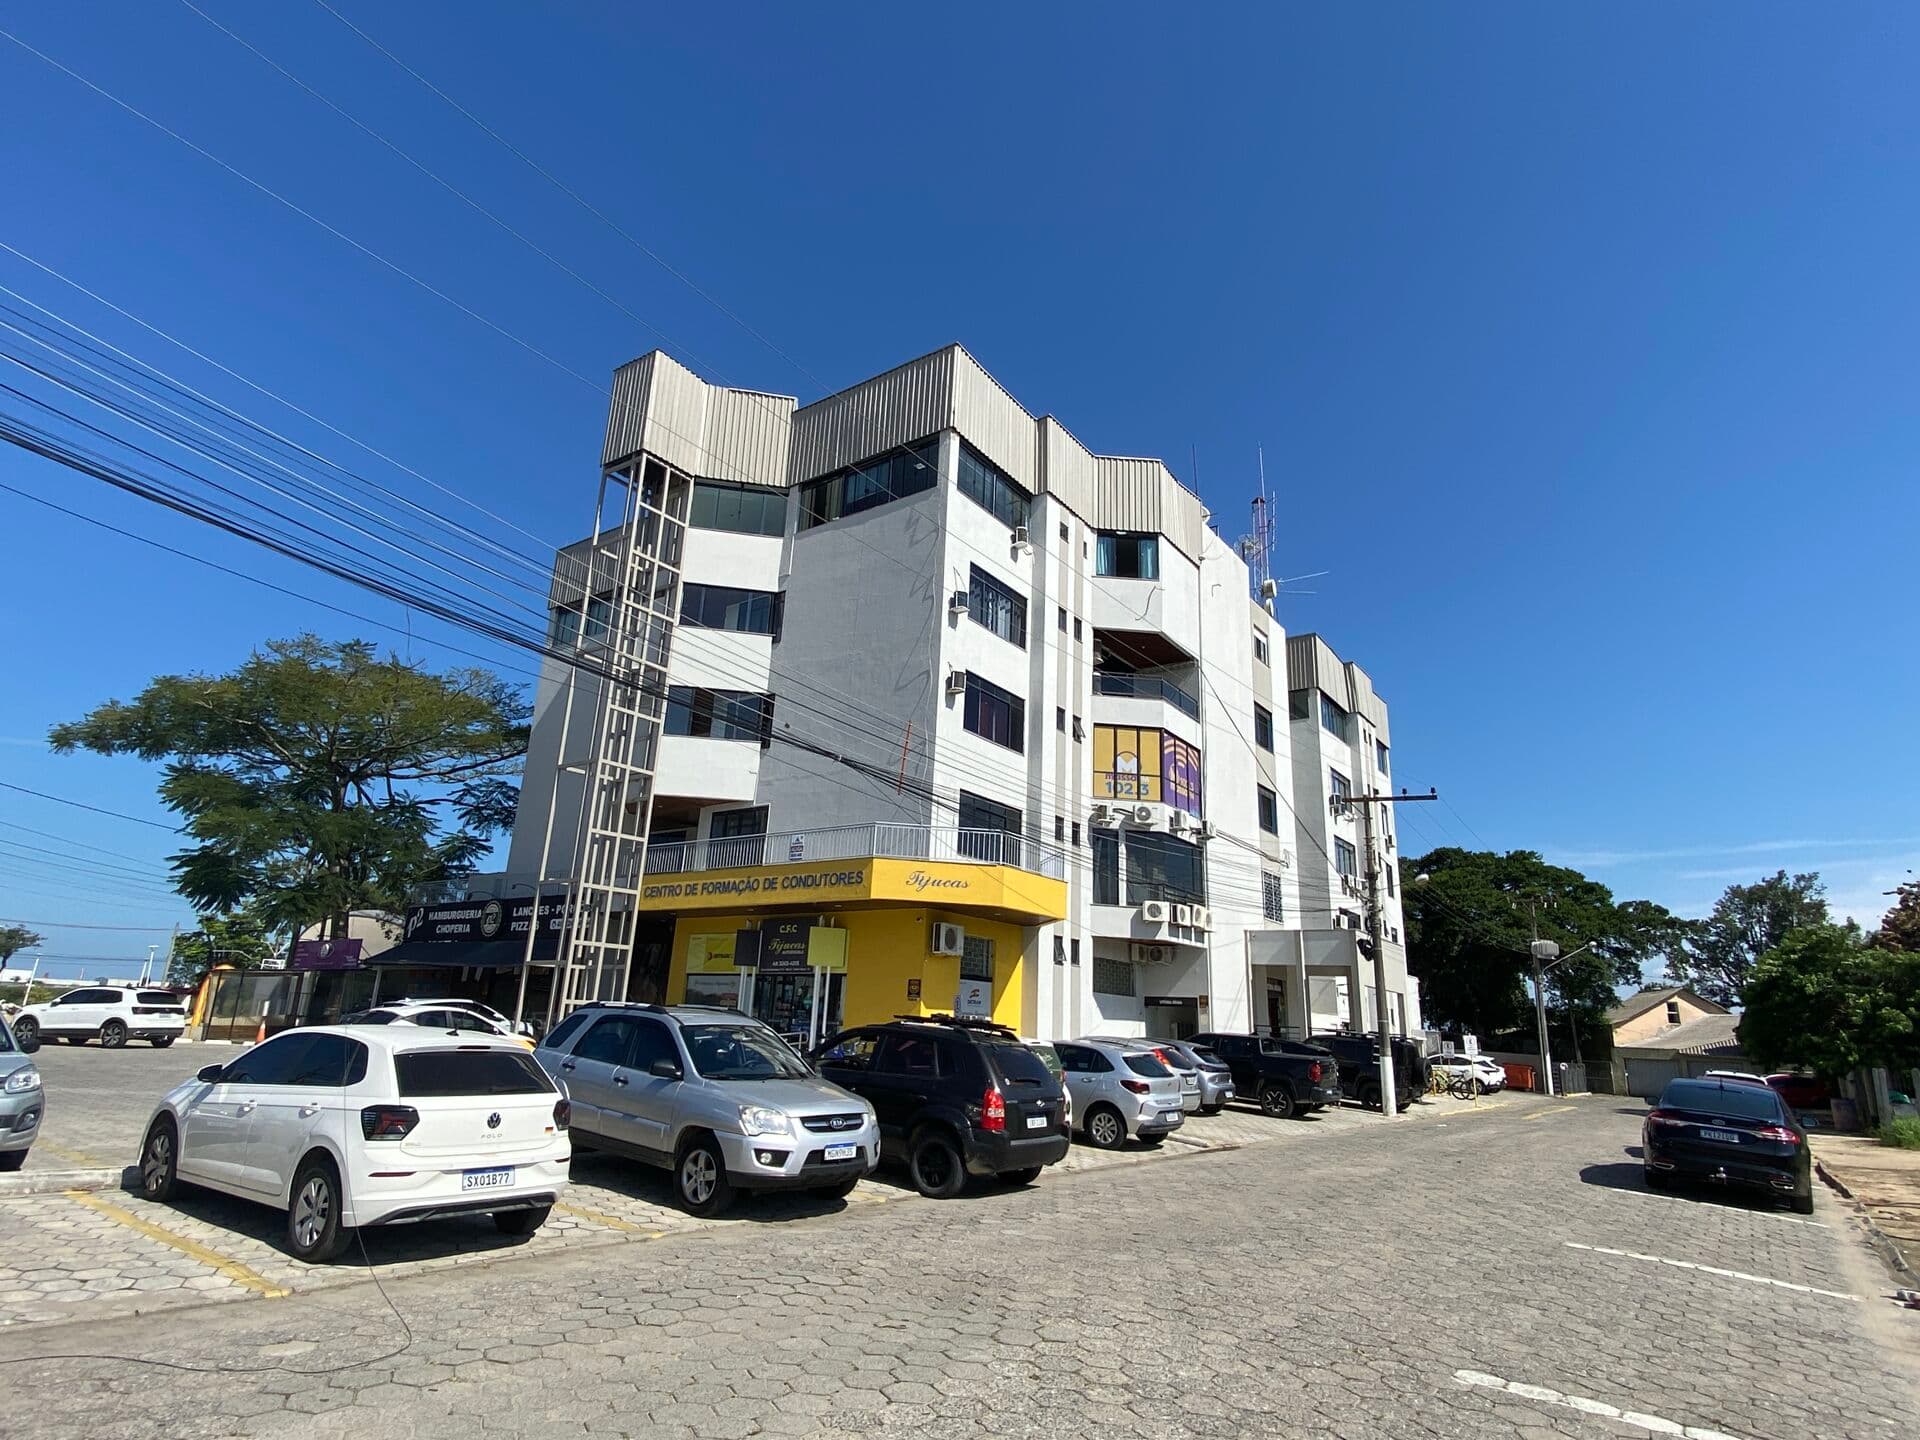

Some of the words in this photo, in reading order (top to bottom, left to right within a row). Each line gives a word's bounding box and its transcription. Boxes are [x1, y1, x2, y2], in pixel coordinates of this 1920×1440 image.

[644, 884, 683, 898] CENTRO
[685, 883, 698, 897] DE
[700, 876, 760, 896] FORMAÇÃO
[763, 877, 778, 890] DE
[782, 870, 864, 888] CONDUTORES
[429, 909, 482, 921] HAMBURGUERIA
[513, 905, 550, 917] LANCES
[436, 924, 471, 934] CHOPERIA
[511, 921, 540, 931] PIZZS
